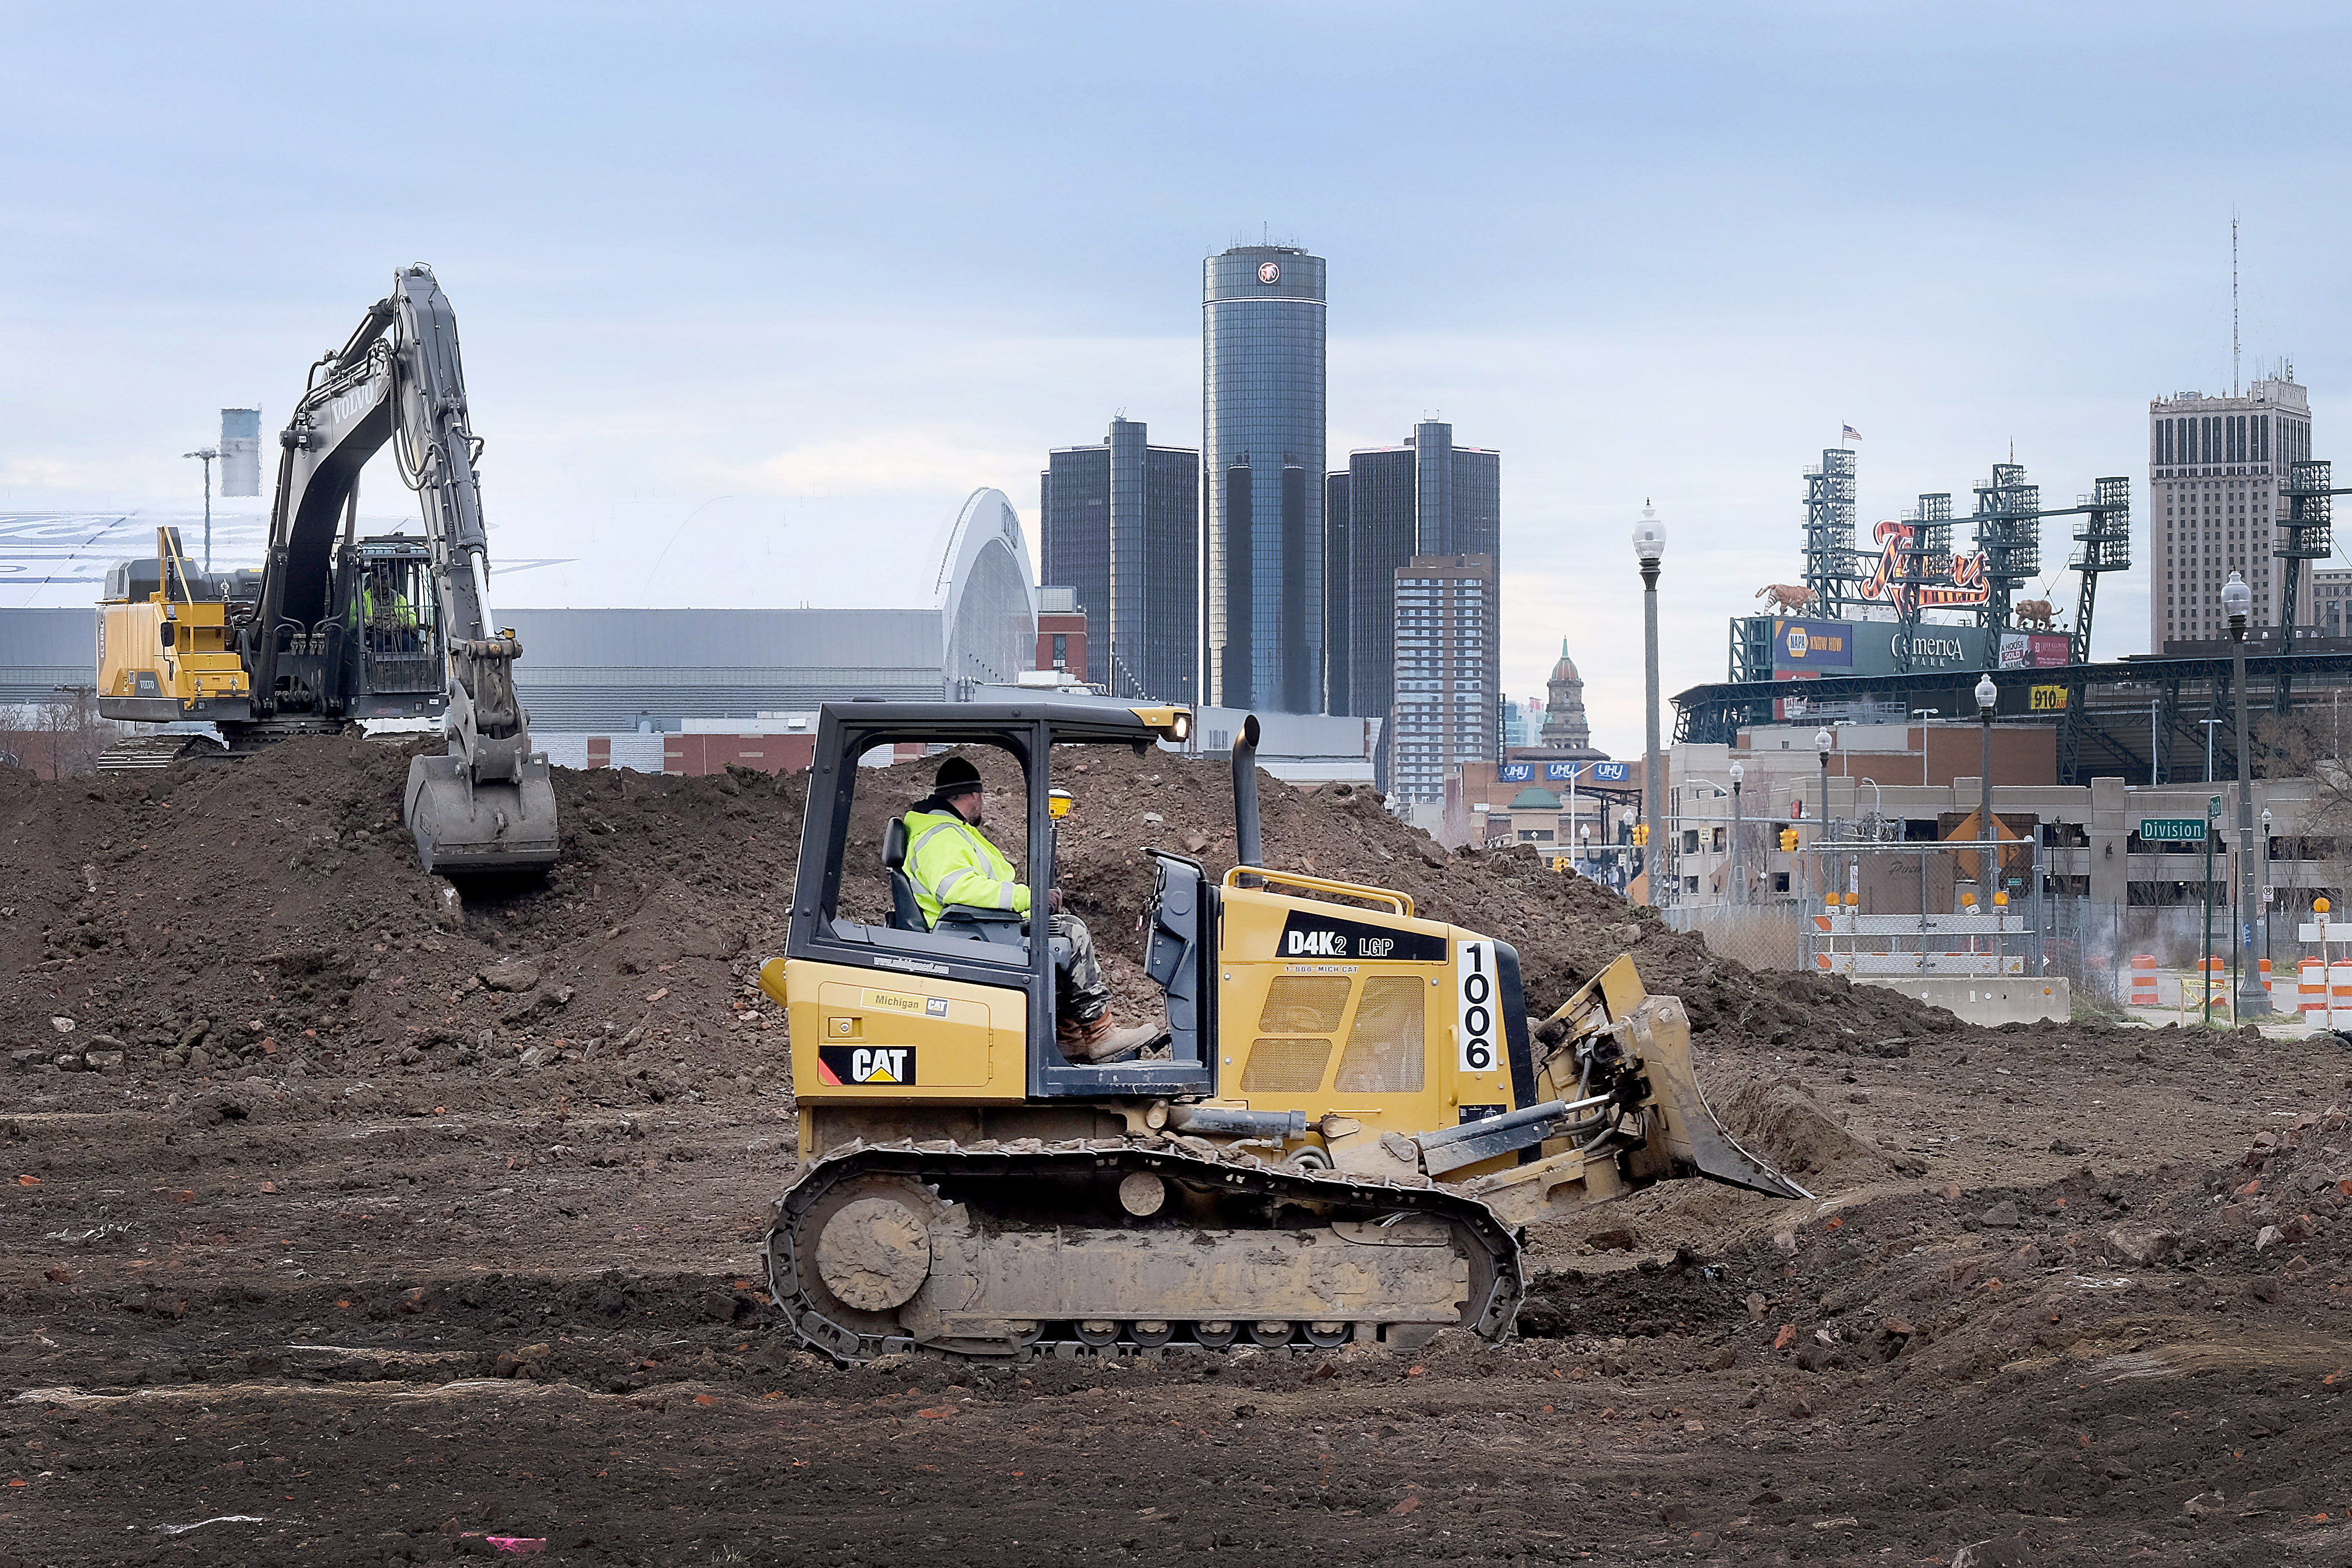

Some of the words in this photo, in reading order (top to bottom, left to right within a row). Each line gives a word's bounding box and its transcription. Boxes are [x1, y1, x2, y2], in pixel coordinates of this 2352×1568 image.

[331, 381, 374, 425] VOLVO
[1790, 635, 1805, 649] NAPA
[1810, 636, 1827, 650] KNOW
[1829, 637, 1843, 651] HOW
[1912, 656, 1945, 667] PARK
[2005, 651, 2021, 660] SOLD
[140, 680, 155, 689] VOLVO
[2035, 690, 2057, 708] 910
[1598, 764, 1623, 779] UHY
[2145, 822, 2200, 837] Division
[1288, 930, 1347, 955] D4K2
[1359, 938, 1394, 957] LGP
[876, 995, 919, 1009] Michigan
[927, 999, 947, 1012] CAT
[1464, 943, 1490, 1069] 1006
[852, 1048, 907, 1082] CAT
